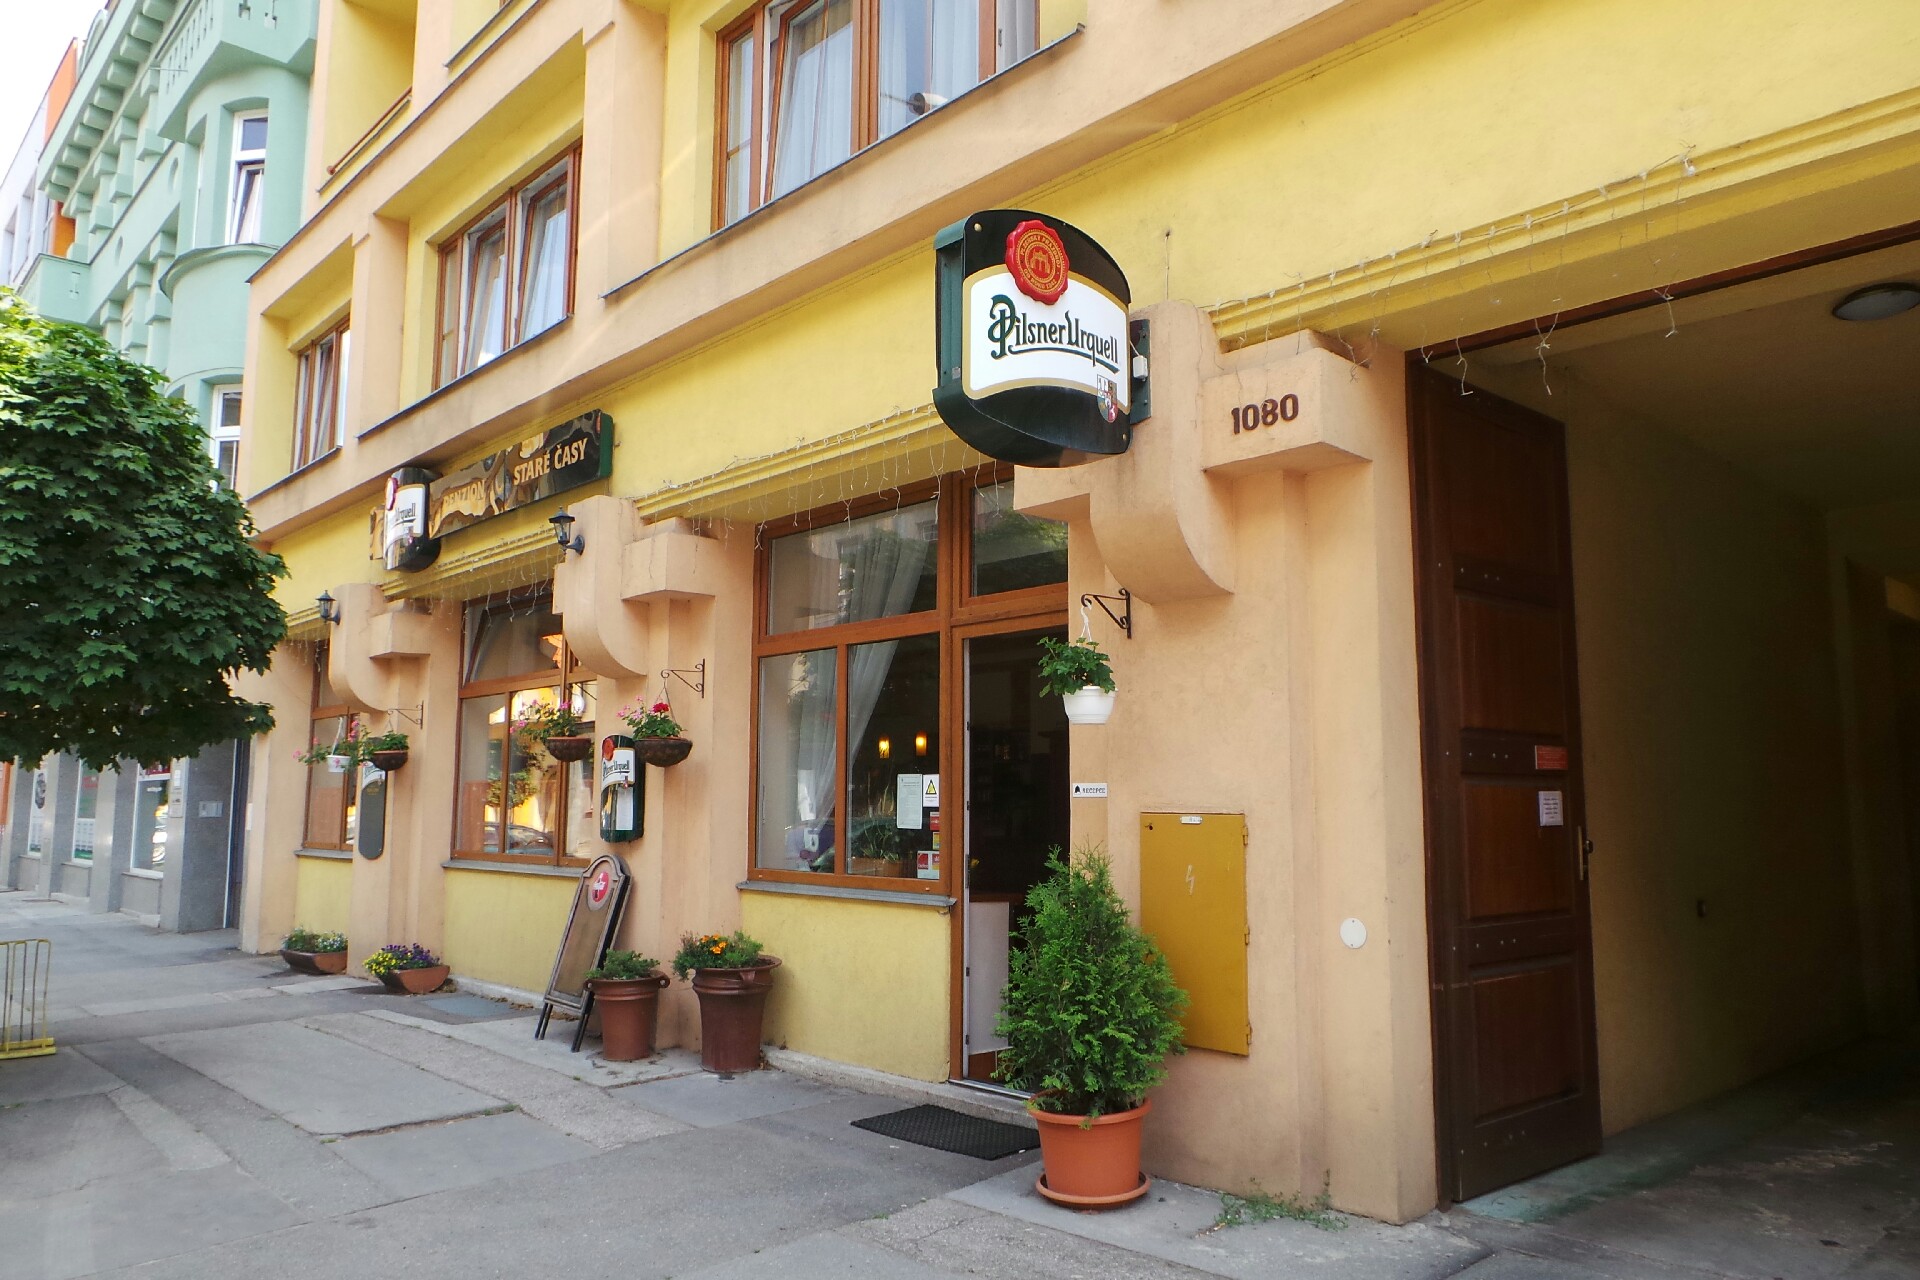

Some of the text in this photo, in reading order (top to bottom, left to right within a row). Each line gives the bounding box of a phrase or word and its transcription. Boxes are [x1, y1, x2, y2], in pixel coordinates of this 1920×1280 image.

[988, 294, 1119, 367] Pilsner Urquell
[1231, 394, 1299, 435] 1080
[513, 437, 588, 486] STARÉ ČASY
